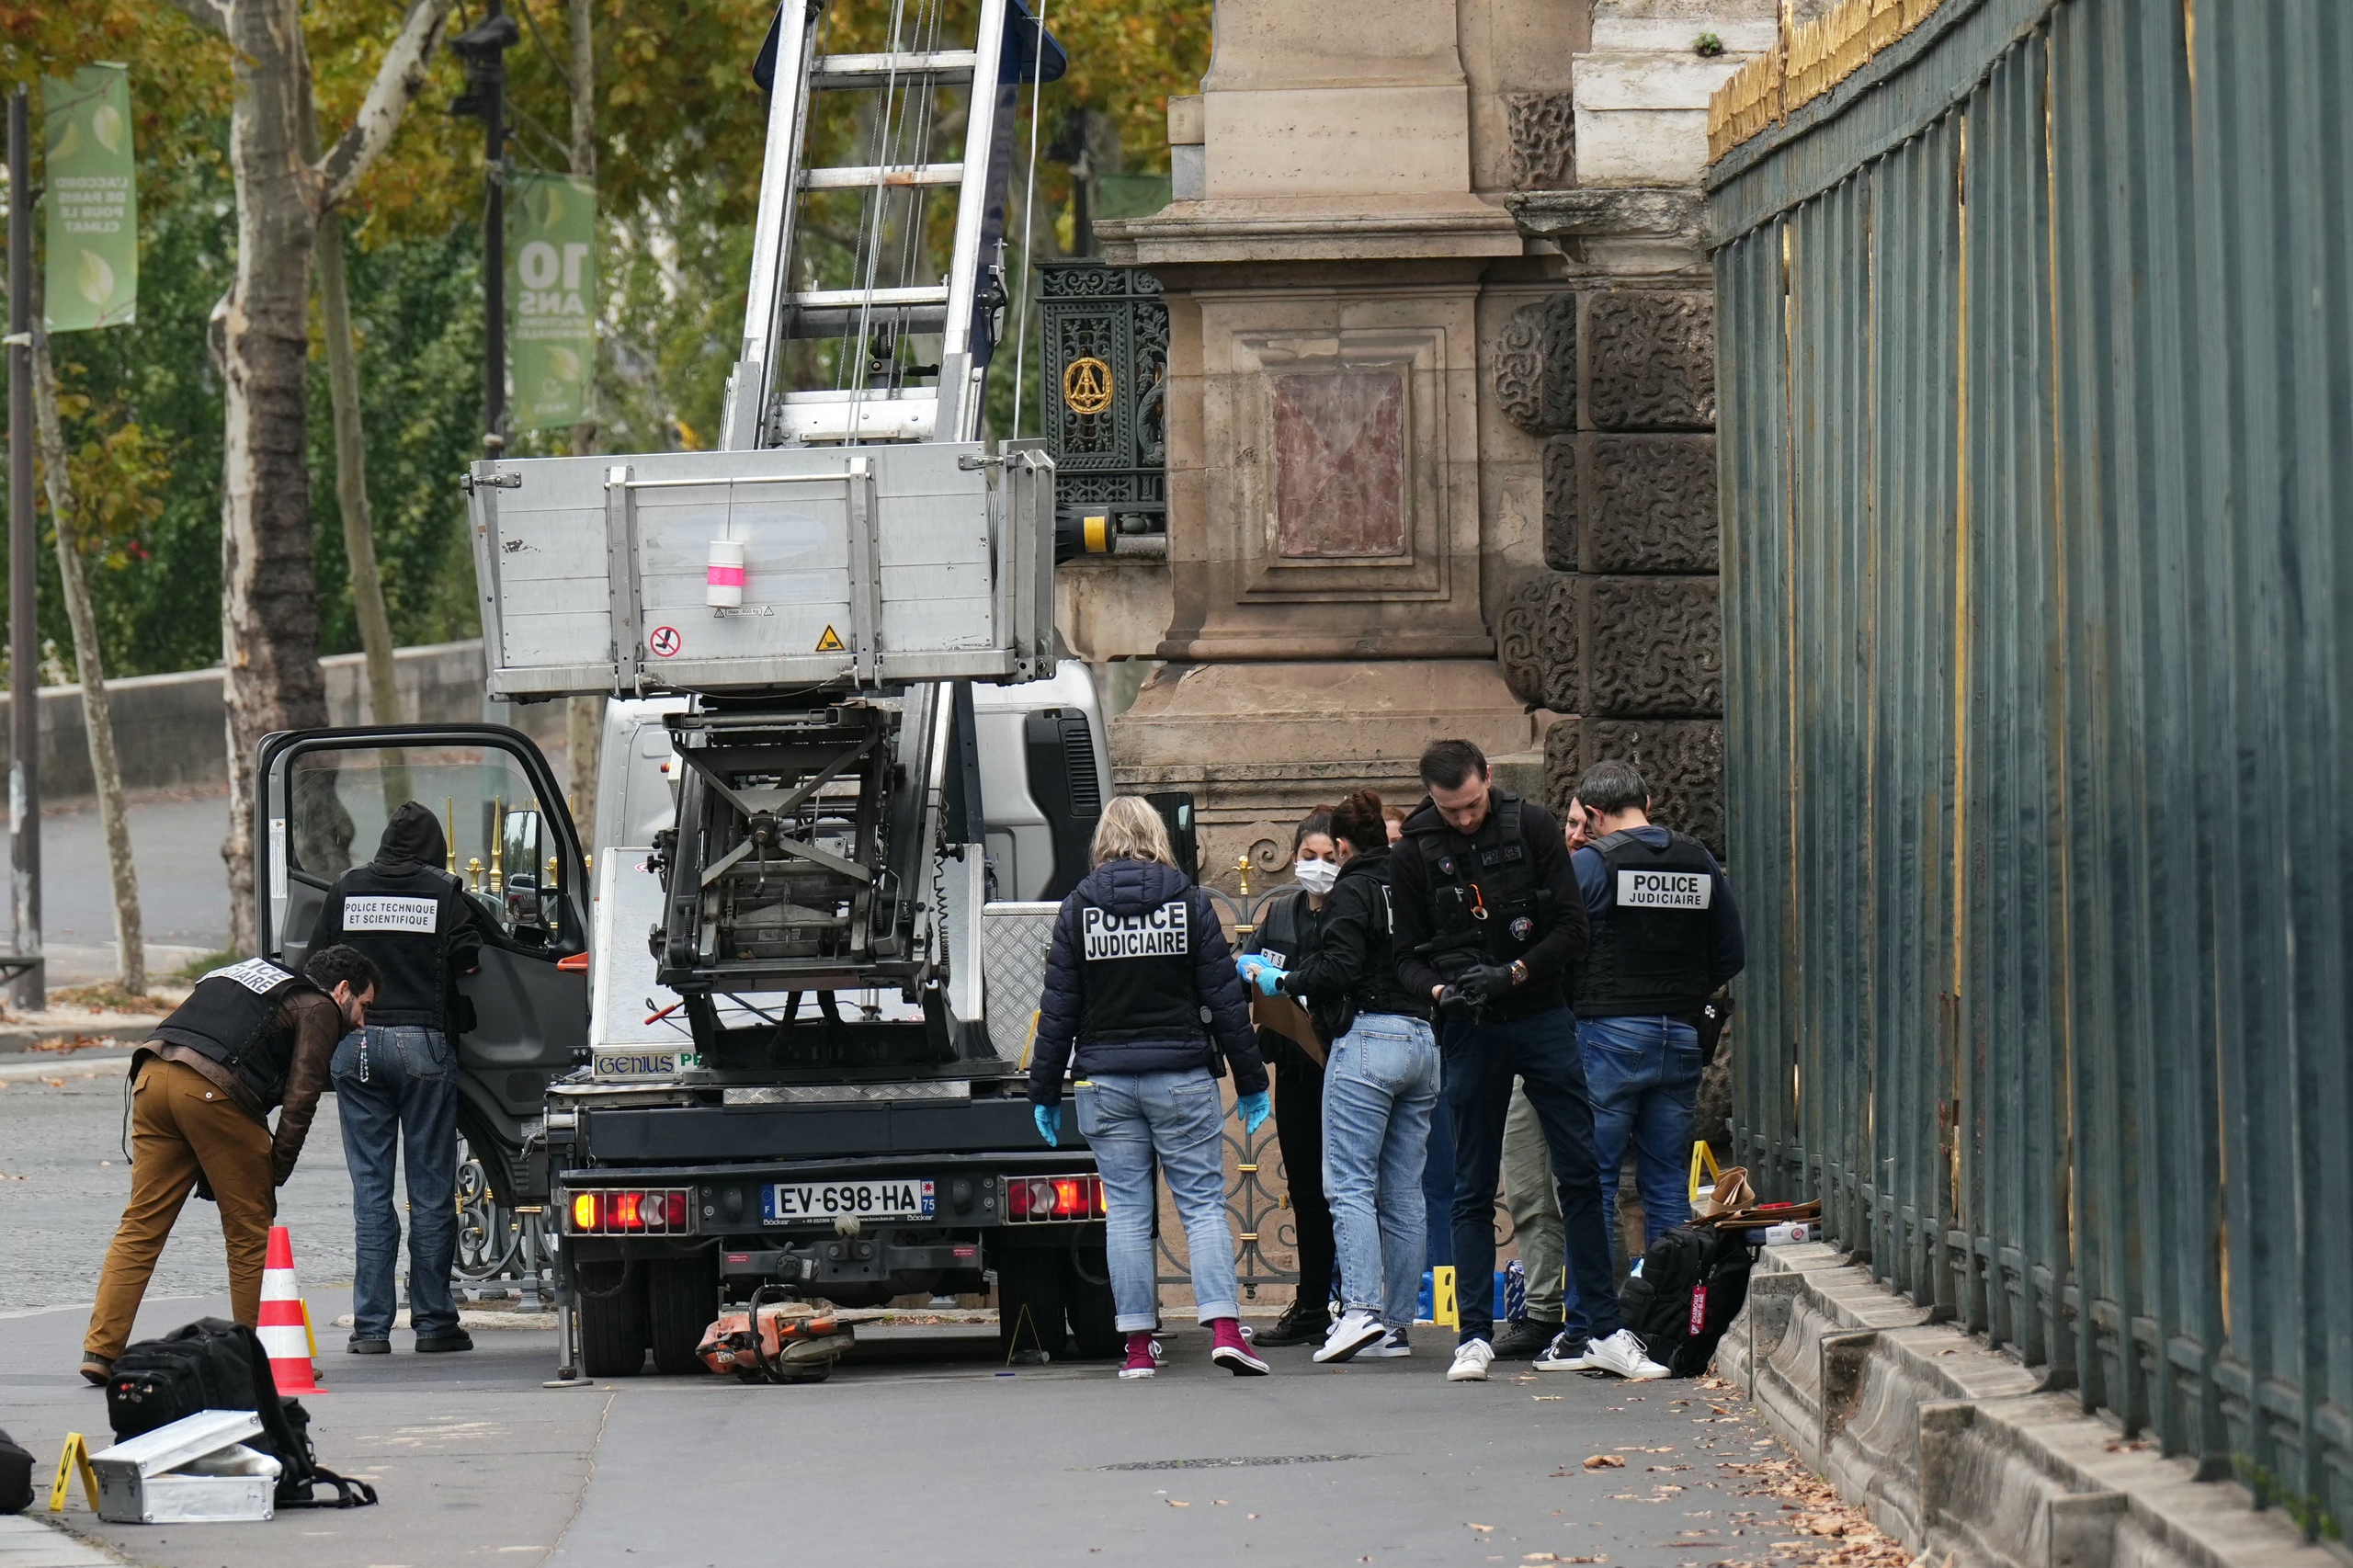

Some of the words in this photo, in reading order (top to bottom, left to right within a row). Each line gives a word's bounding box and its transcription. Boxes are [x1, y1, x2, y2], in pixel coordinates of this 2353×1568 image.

[1483, 846, 1519, 859] POCE
[1634, 875, 1698, 892] POLICE
[1629, 892, 1701, 905] JUDICIAIRE
[345, 903, 377, 912] POLICE
[381, 903, 435, 914] TECHNIQUE
[349, 915, 359, 924] ET
[363, 915, 428, 926] SCIENTIFIQUE
[1086, 904, 1185, 934] POLICE
[1087, 931, 1186, 958] JUDICIAIRE
[599, 1055, 674, 1074] GENIUS
[765, 1205, 770, 1214] F
[780, 1185, 915, 1213] EV-698-HA
[922, 1199, 935, 1210] 75
[57, 1442, 73, 1493] 9
